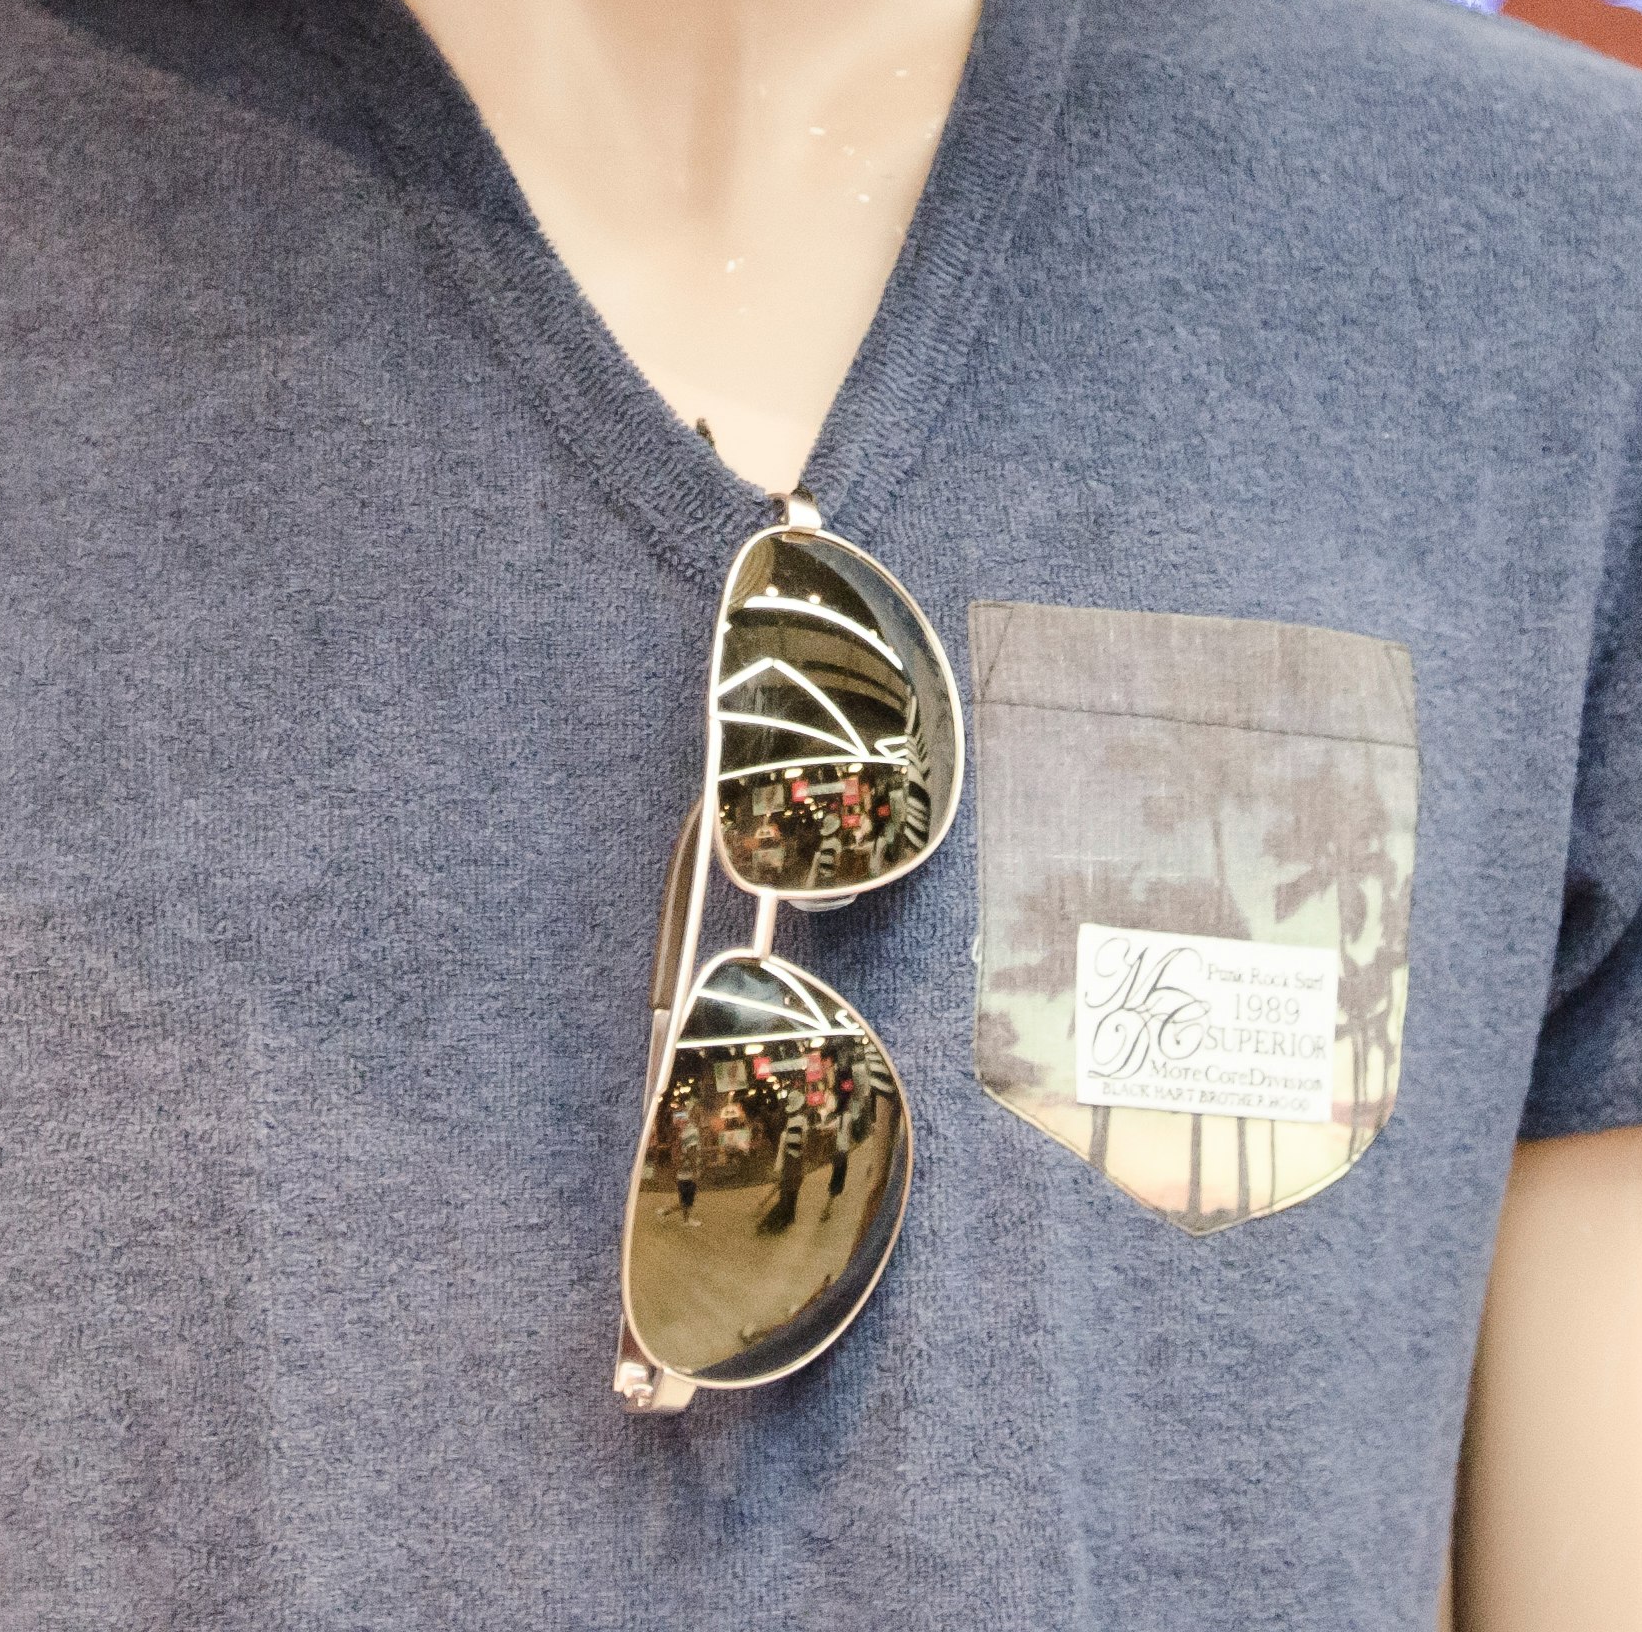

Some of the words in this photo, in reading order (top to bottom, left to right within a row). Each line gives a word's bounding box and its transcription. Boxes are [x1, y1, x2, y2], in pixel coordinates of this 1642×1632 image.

[1249, 966, 1288, 988] Rock
[1235, 993, 1300, 1025] 1989
[1204, 1024, 1327, 1061] SUPERIOR
[1102, 1081, 1150, 1099] BLACK
